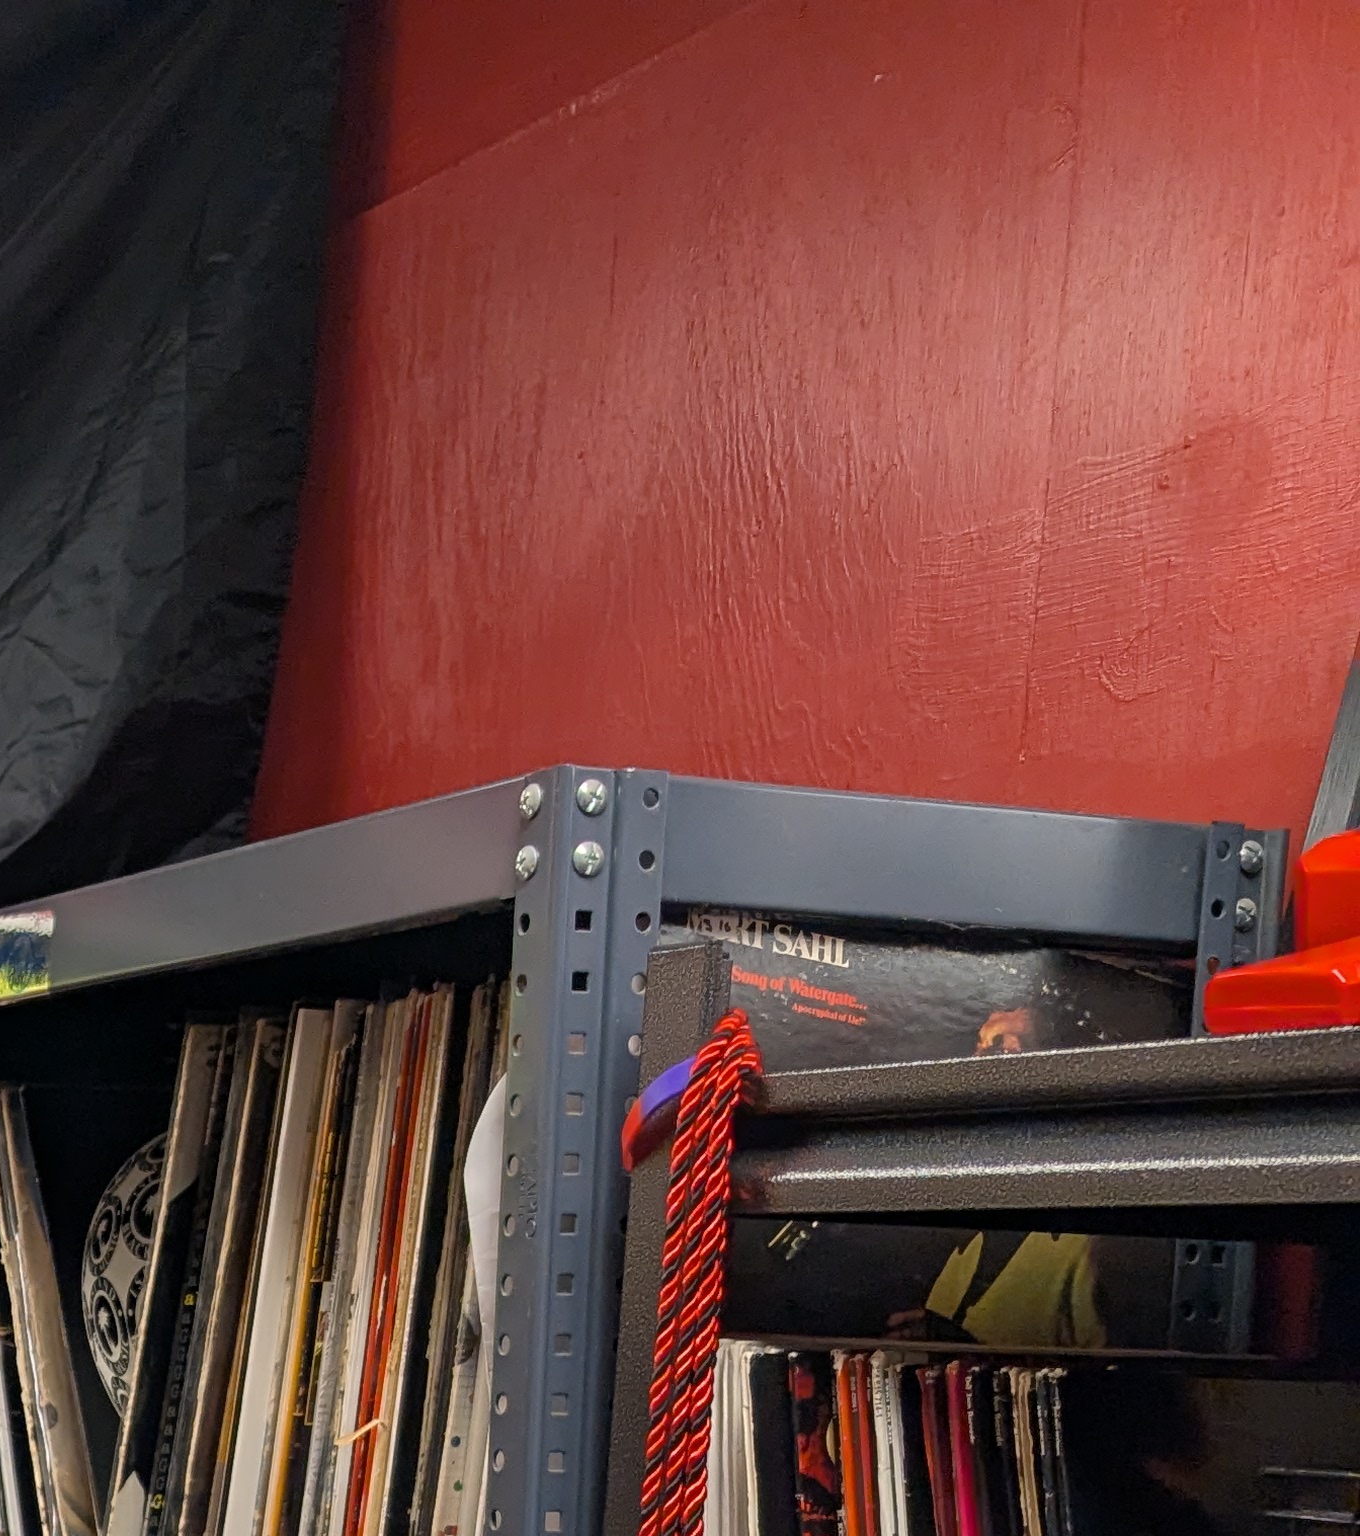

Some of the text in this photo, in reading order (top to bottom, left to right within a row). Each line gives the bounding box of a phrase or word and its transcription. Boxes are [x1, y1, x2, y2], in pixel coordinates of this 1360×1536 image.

[773, 924, 850, 968] SAHL
[731, 965, 768, 992] Song
[769, 976, 786, 992] of
